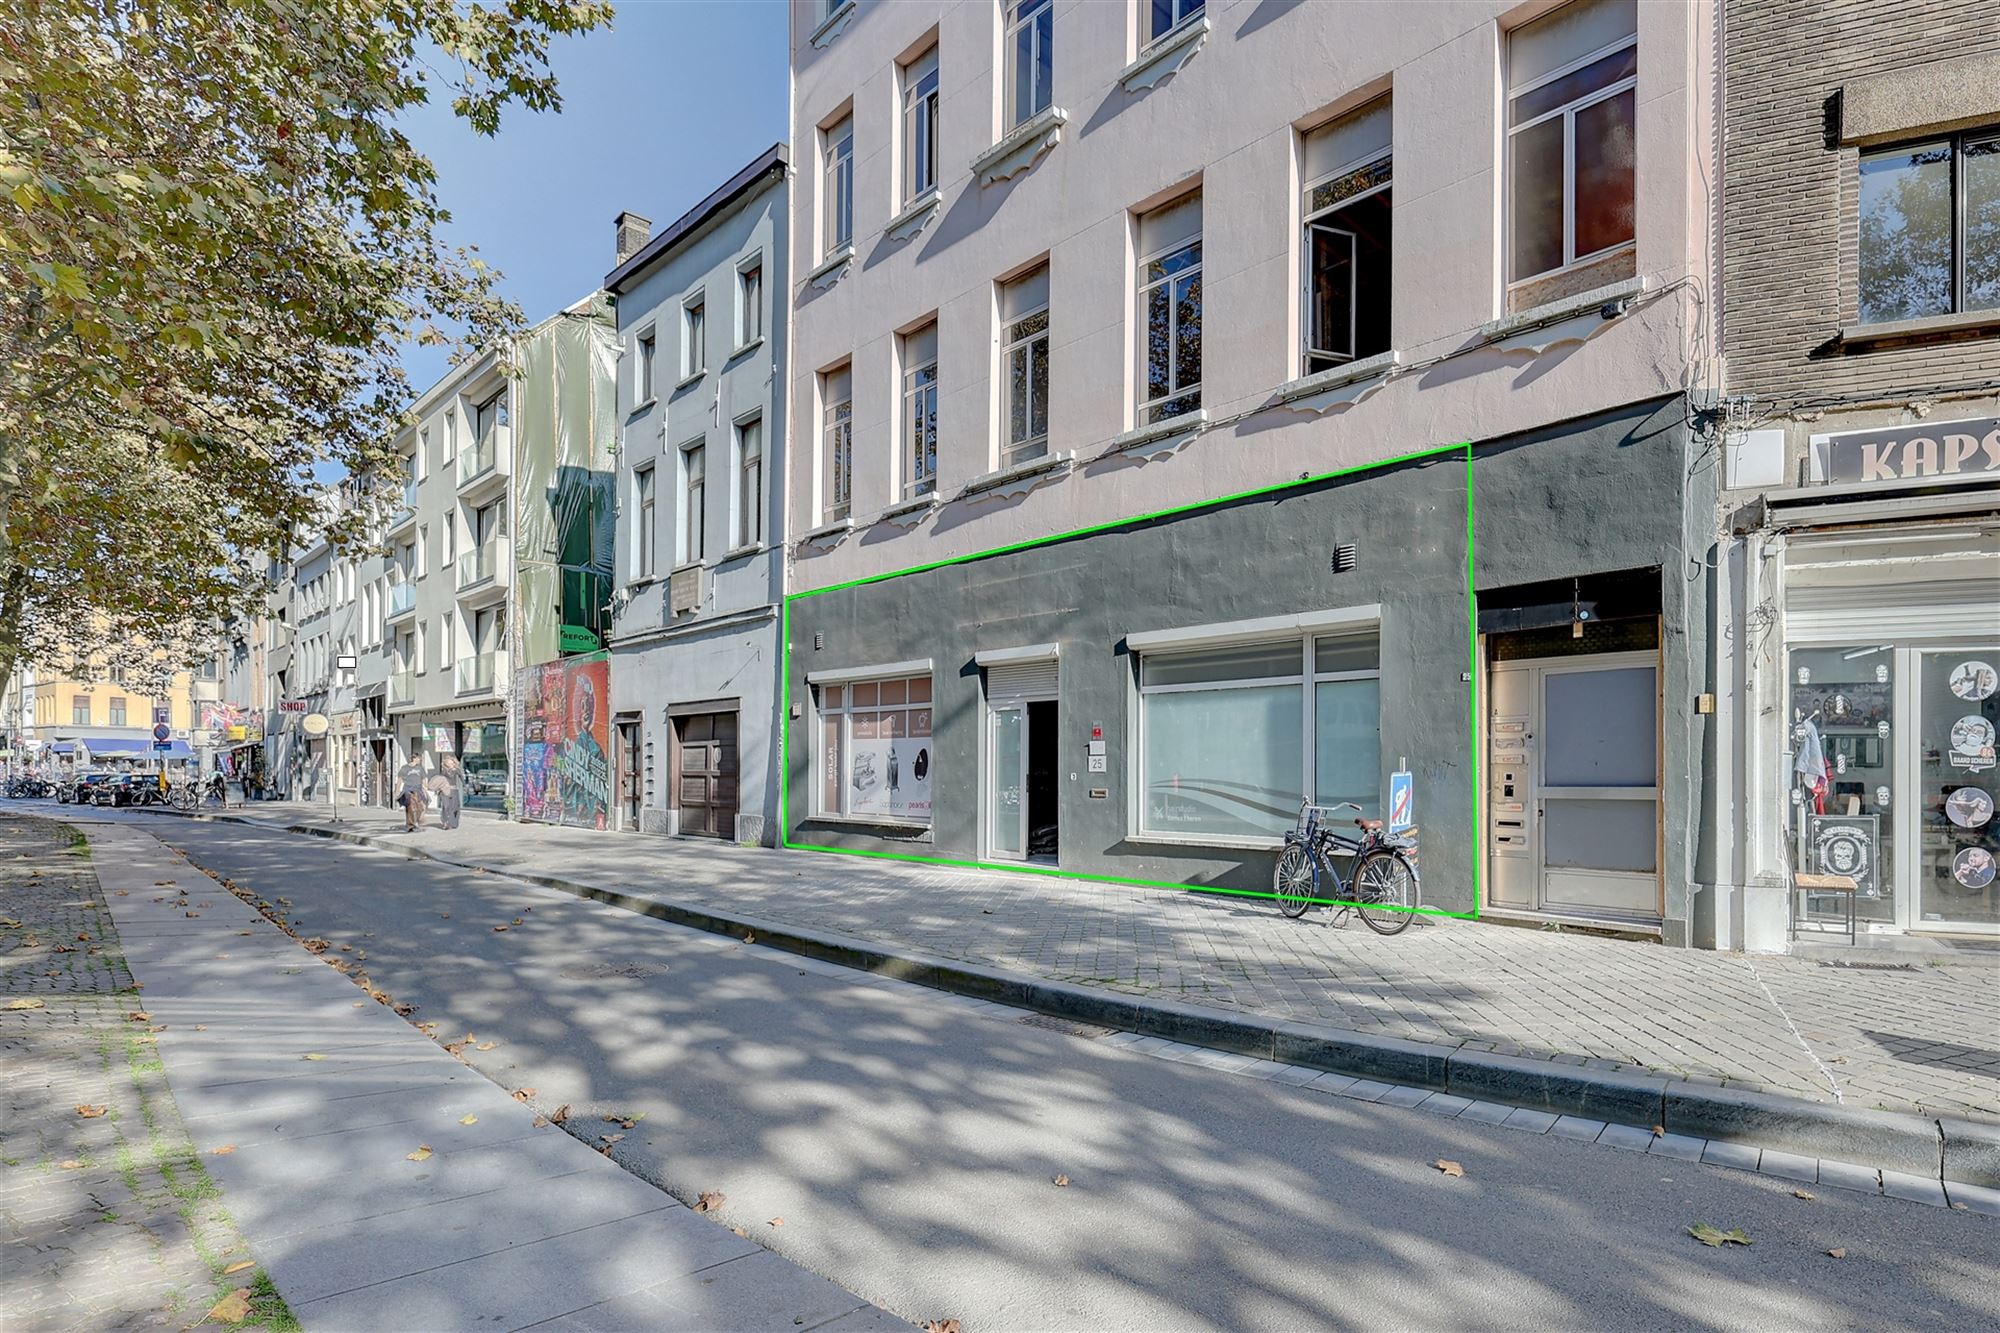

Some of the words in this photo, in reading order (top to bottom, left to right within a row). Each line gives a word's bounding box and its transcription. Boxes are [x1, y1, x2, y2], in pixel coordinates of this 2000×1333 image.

[1861, 429, 2000, 482] KAPS
[281, 702, 305, 712] SHOP
[564, 738, 590, 770] CINDY
[1092, 759, 1102, 769] 25
[565, 756, 608, 804] SHERMAN
